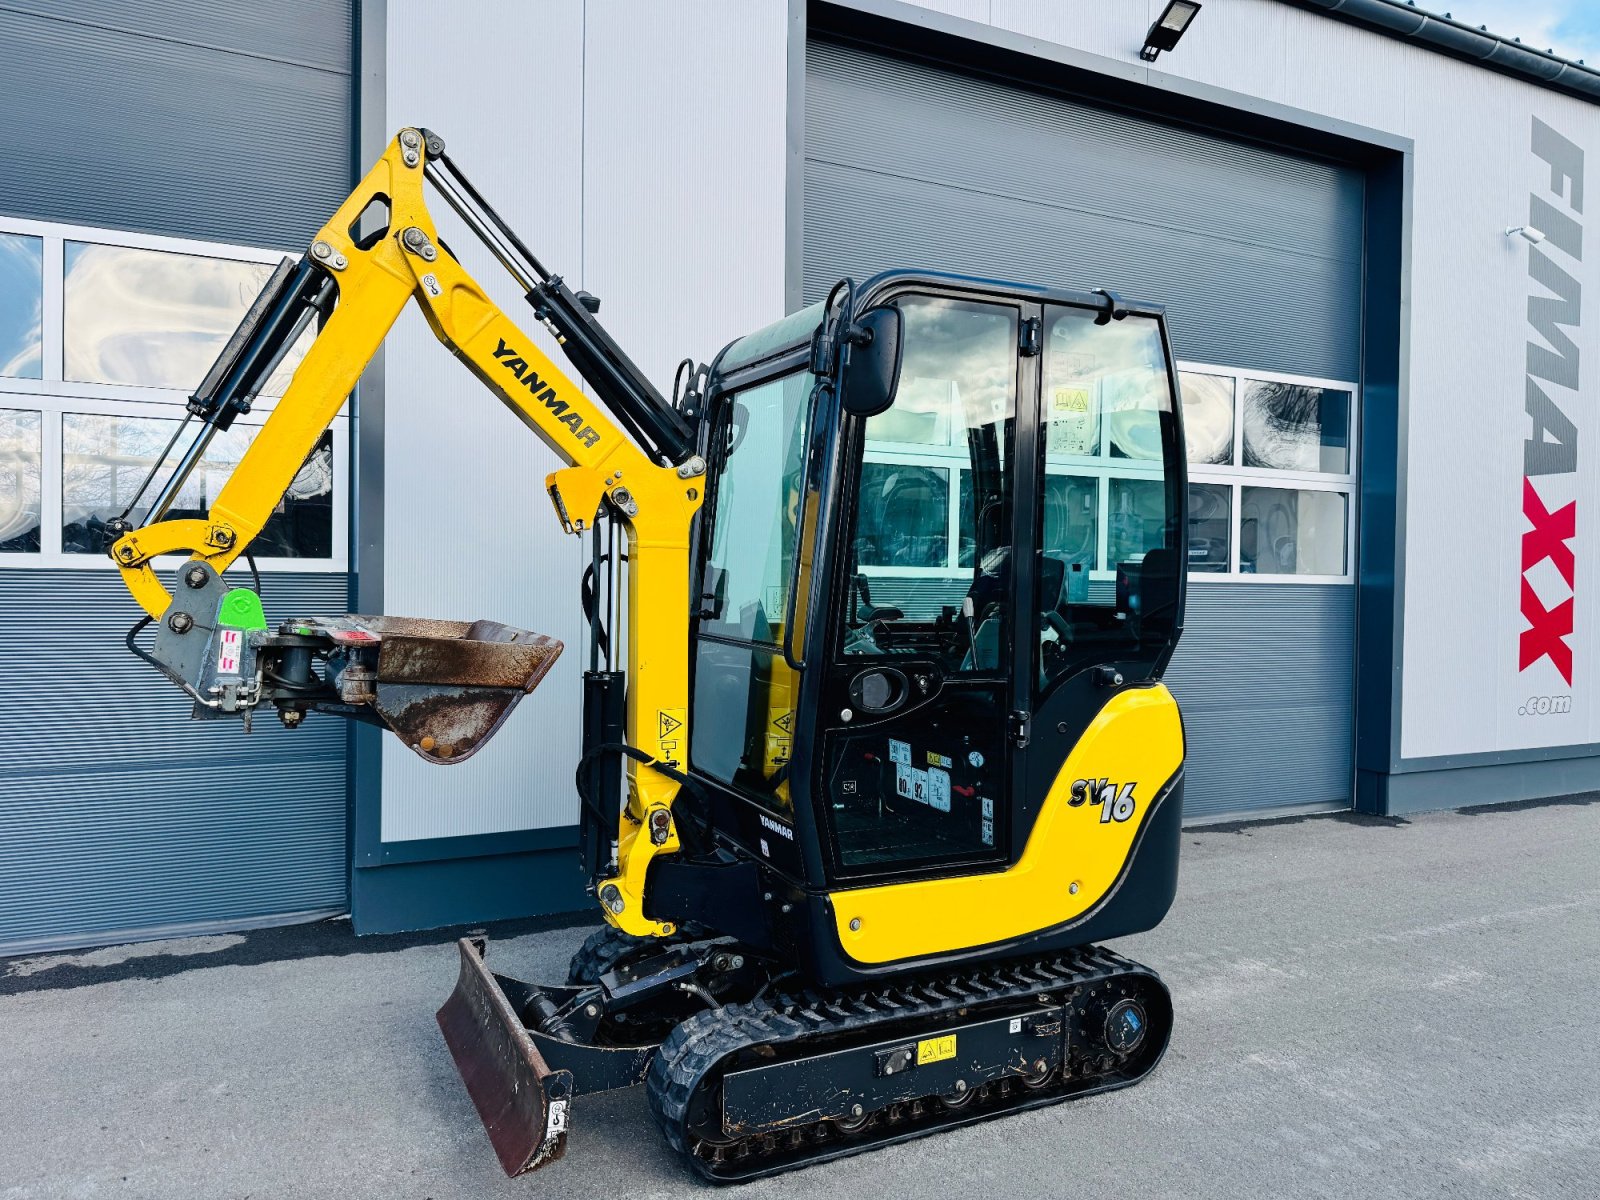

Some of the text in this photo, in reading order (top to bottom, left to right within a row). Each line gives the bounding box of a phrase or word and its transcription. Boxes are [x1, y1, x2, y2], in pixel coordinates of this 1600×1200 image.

[492, 337, 601, 449] YANMAR
[1518, 114, 1585, 688] FIMAXX
[1517, 695, 1572, 716] .com
[759, 814, 793, 841] YANMAR
